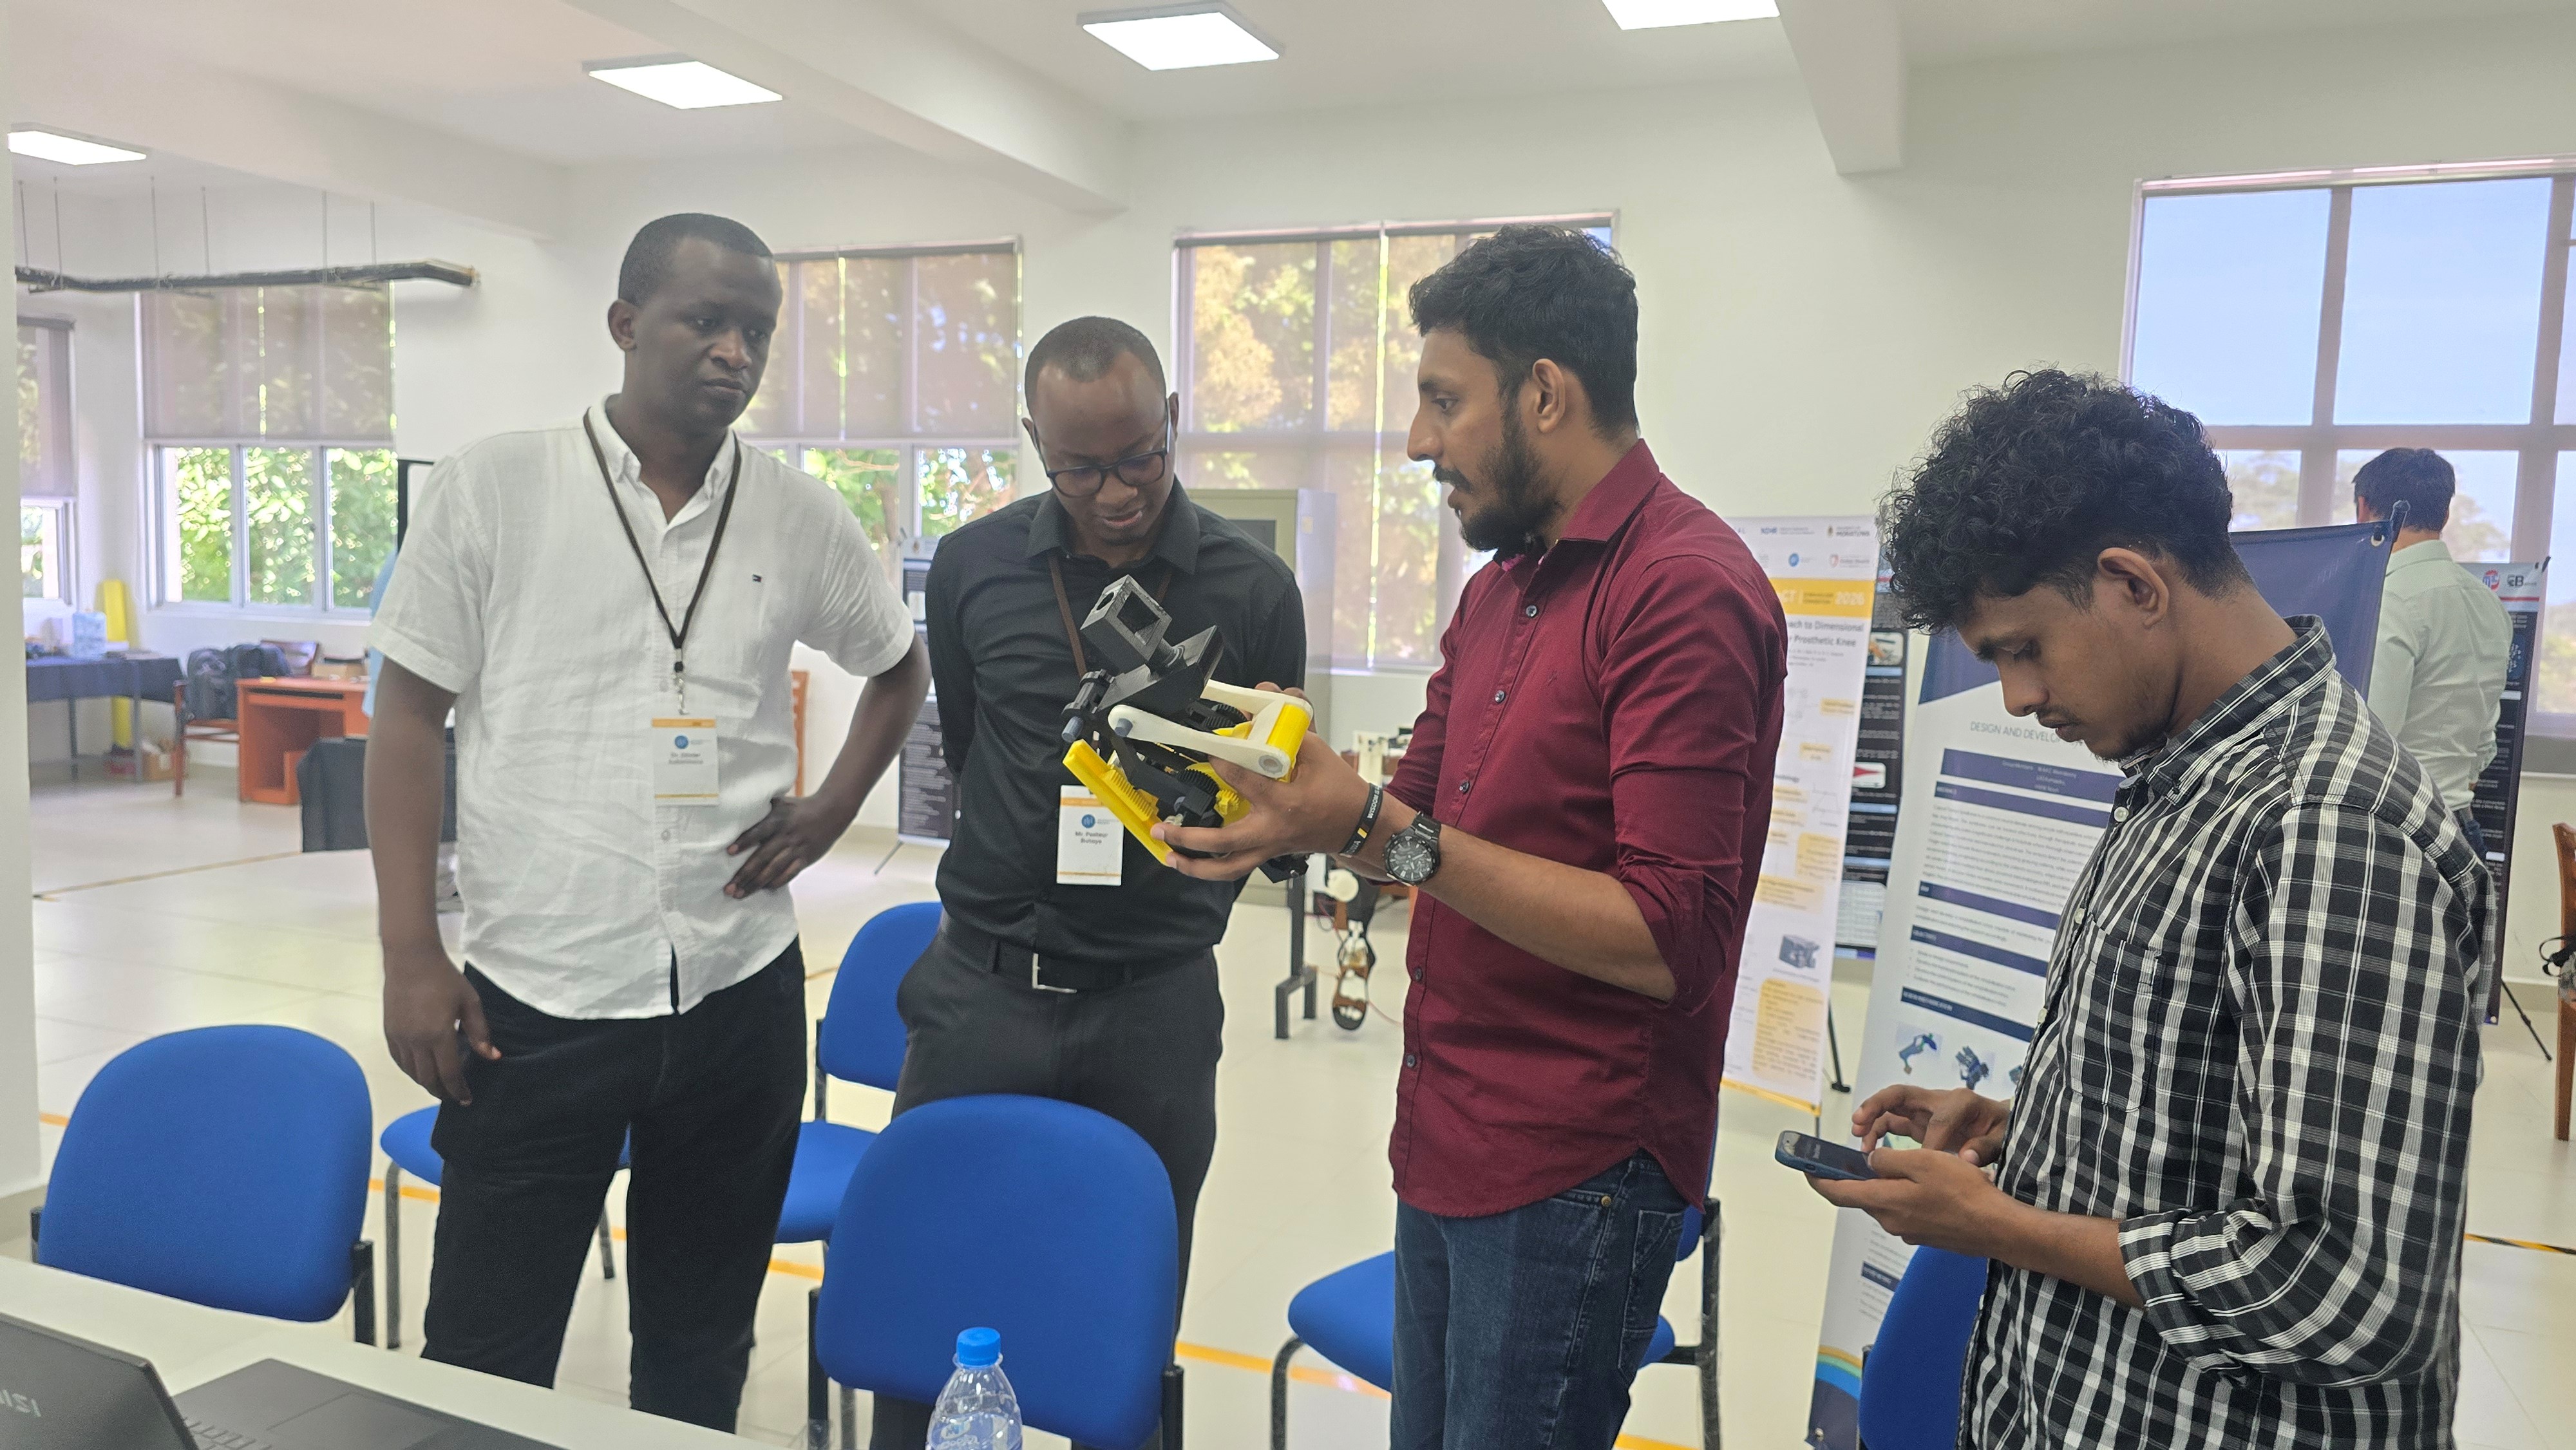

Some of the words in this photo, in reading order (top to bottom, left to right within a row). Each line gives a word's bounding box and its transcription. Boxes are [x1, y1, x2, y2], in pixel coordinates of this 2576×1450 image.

[1814, 620, 1865, 632] Dimensional
[1794, 635, 1834, 646] Prosthetic
[1837, 637, 1856, 647] Knee
[1970, 720, 2001, 734] DESIGN
[2003, 726, 2022, 738] AND
